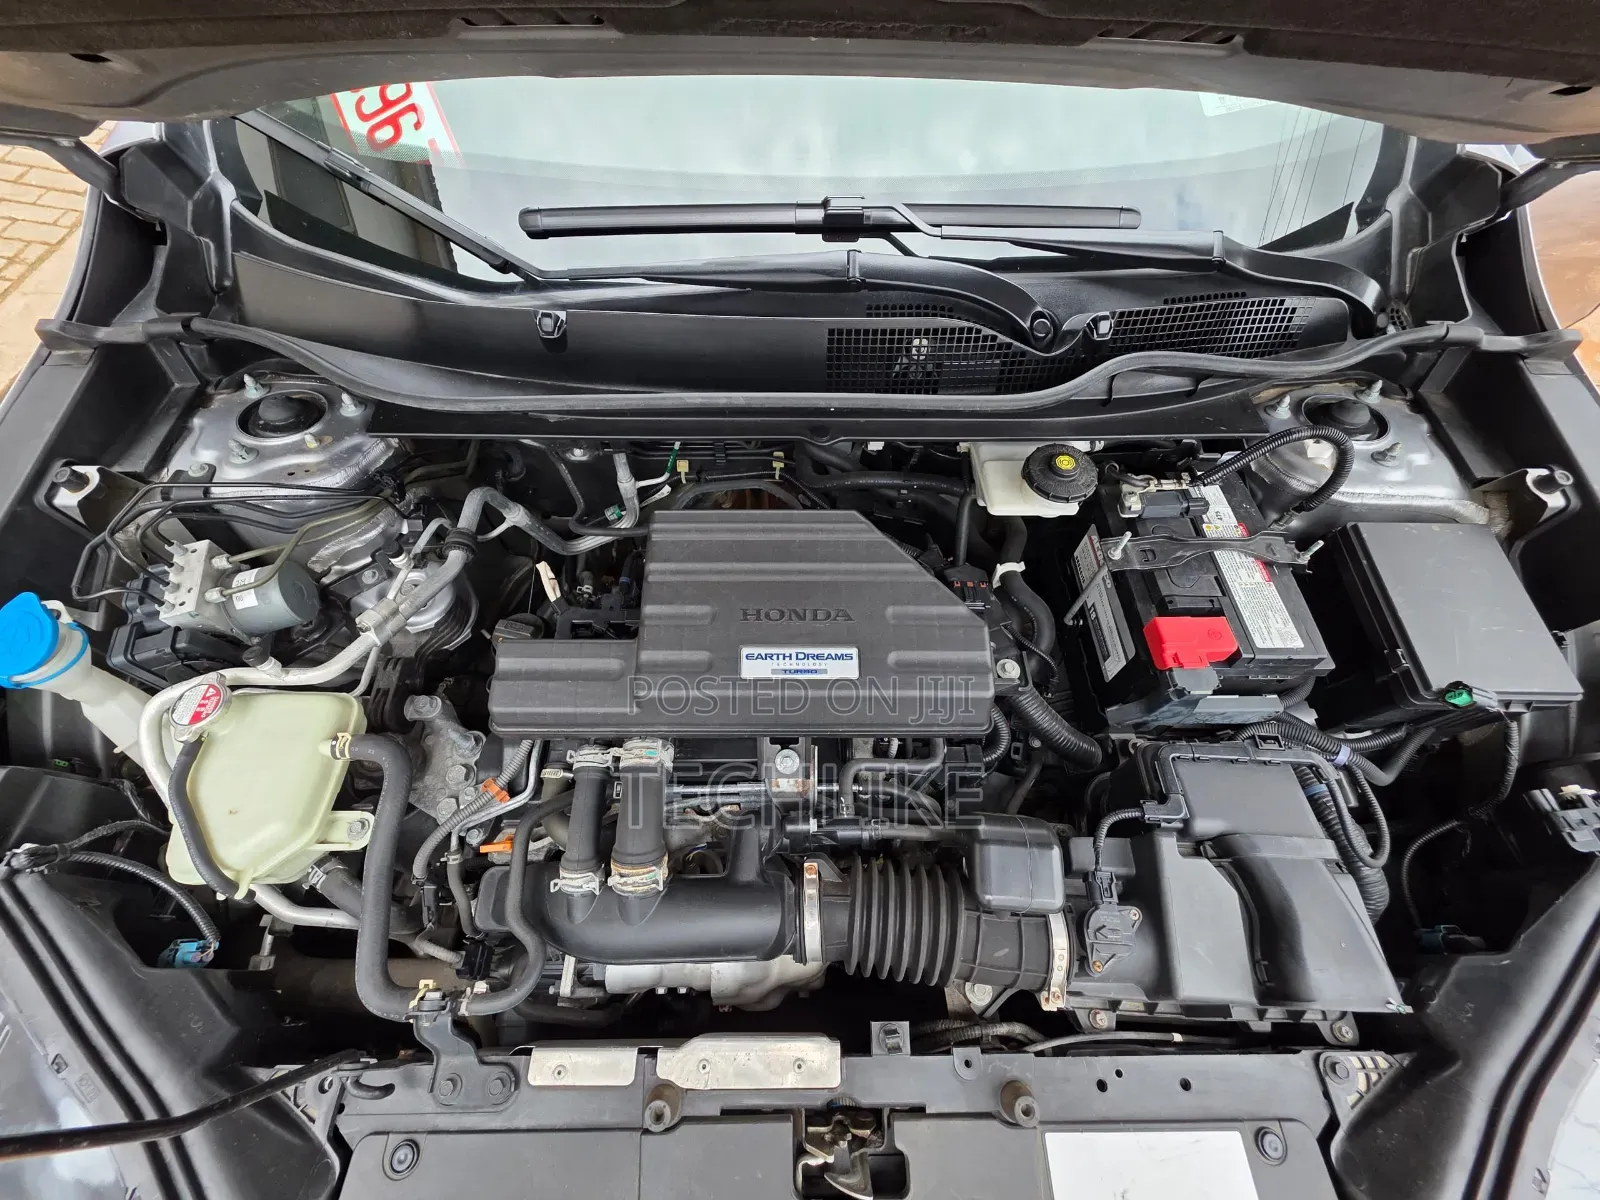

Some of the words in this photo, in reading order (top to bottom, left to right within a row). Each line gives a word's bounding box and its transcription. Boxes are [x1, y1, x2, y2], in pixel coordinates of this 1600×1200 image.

[739, 608, 855, 622] HONDA
[745, 652, 792, 661] EARTH
[795, 651, 853, 661] DREAMS
